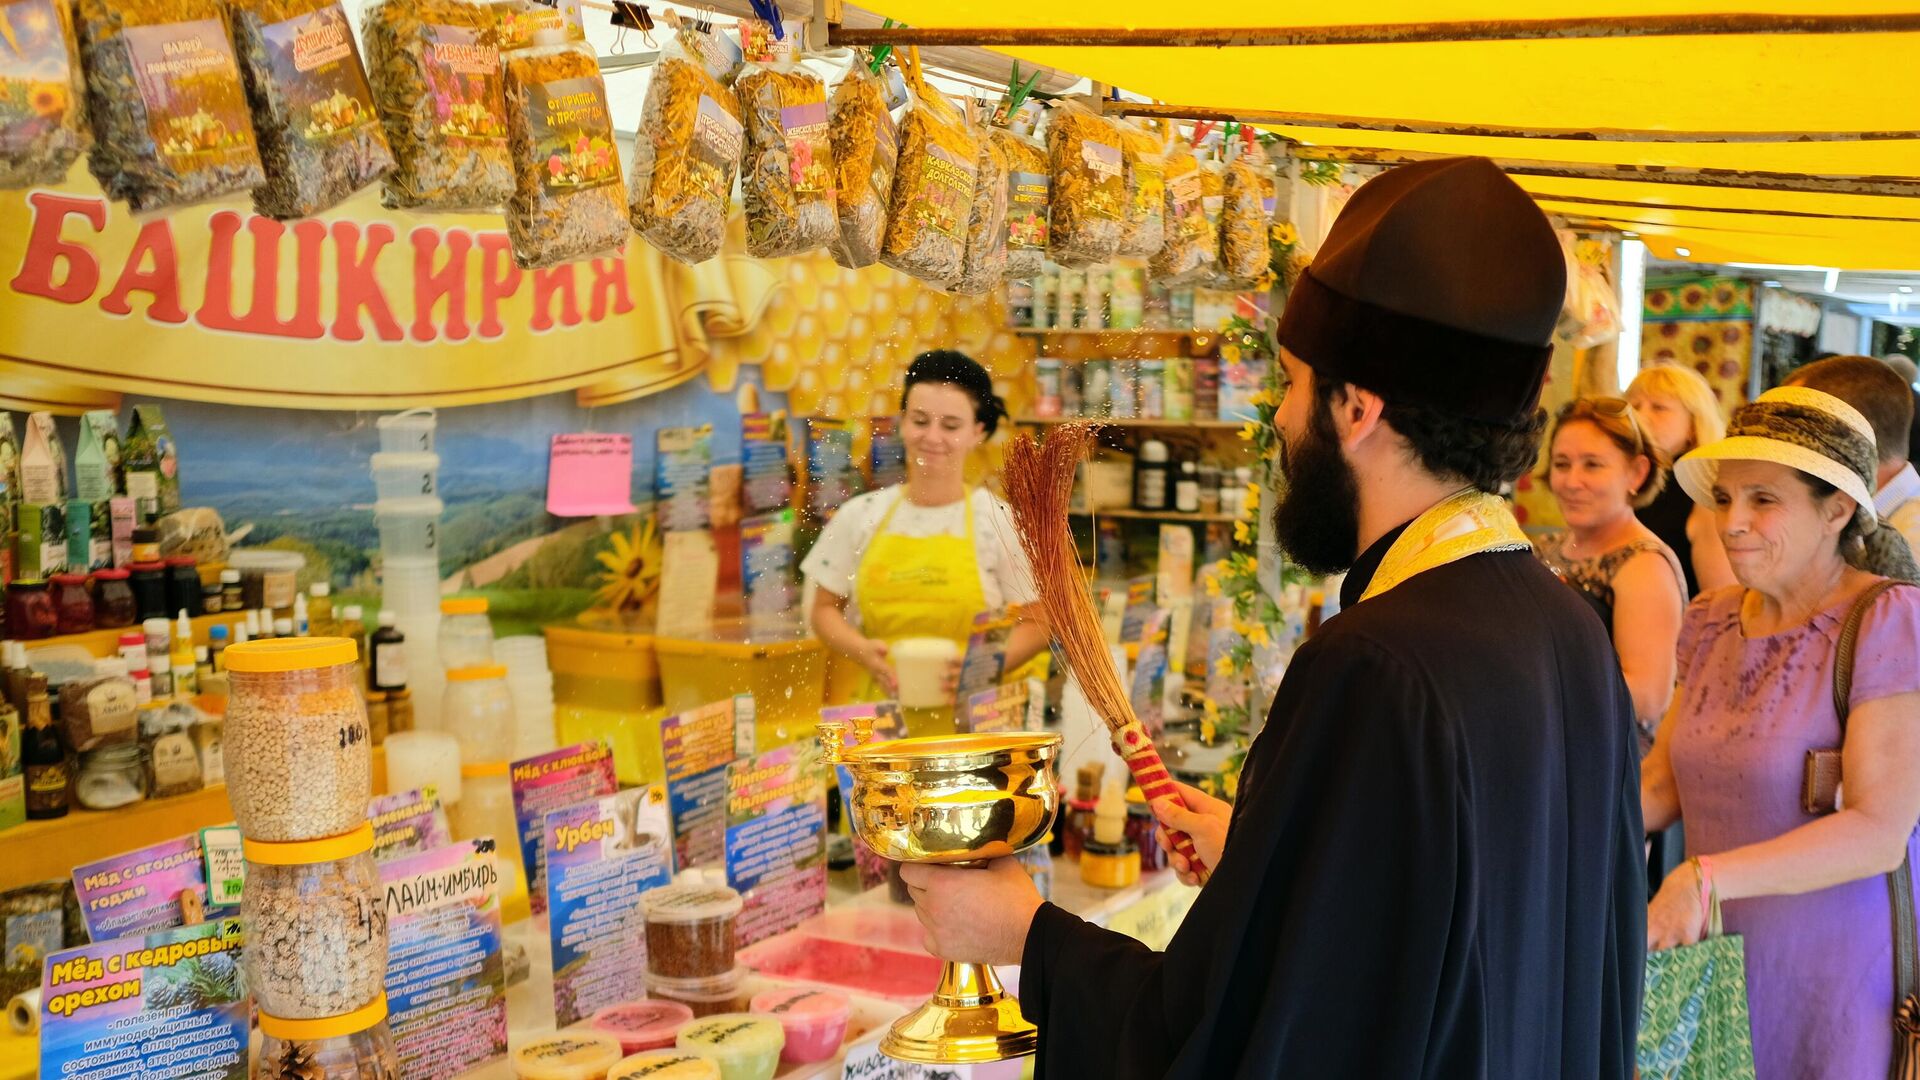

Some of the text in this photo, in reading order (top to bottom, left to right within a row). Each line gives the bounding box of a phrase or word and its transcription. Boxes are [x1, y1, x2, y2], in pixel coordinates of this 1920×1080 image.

[547, 90, 598, 110] ОТ ГРИППА
[547, 106, 602, 126] И ПРОСТУДЫ
[10, 192, 635, 341] БАШКИРИЯ
[421, 473, 433, 495] 2
[425, 522, 436, 549] 3
[513, 749, 609, 783] Мёд с клюквой
[731, 763, 791, 791] Липово-
[729, 773, 816, 817] Малиновый
[554, 818, 615, 854] Урбеч
[83, 869, 122, 892] Мёд
[122, 869, 134, 880] с
[135, 847, 204, 873] ягодами
[89, 884, 147, 912] годжи
[51, 956, 104, 987] Мёд
[107, 954, 122, 973] с
[47, 977, 142, 1018] орехом
[115, 1003, 192, 1029] полезен при
[62, 1024, 232, 1074] состояниях, аллергических
[84, 1014, 212, 1053] иммунодефицитных
[141, 1063, 193, 1080] болезни
[194, 1051, 240, 1072] сердца,
[147, 1038, 240, 1068] атеросклерозе,
